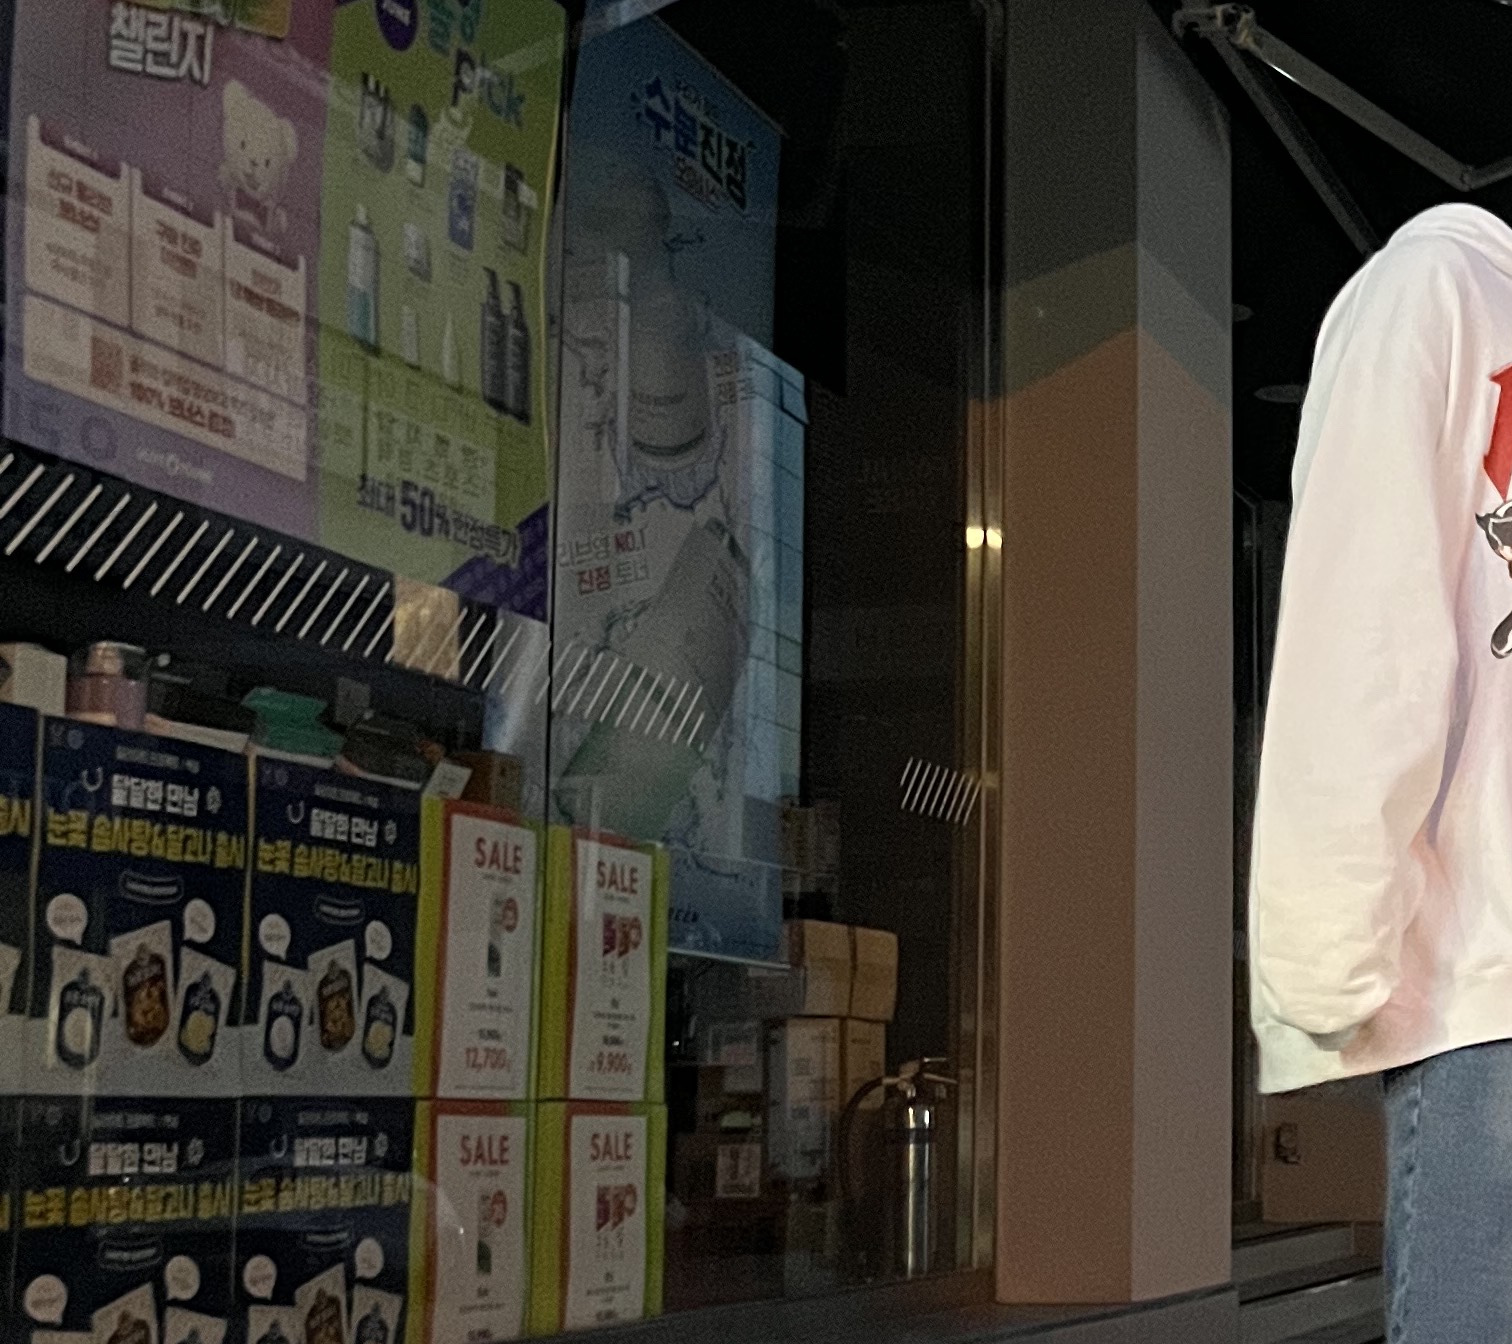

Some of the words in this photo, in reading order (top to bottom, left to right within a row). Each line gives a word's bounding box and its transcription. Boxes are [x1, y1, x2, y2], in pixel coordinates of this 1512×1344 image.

[108, 2, 215, 86] 챌린지
[474, 836, 523, 875] SALE
[596, 860, 640, 896] SALE
[459, 1134, 510, 1167] SALE
[590, 1132, 634, 1162] SALE
